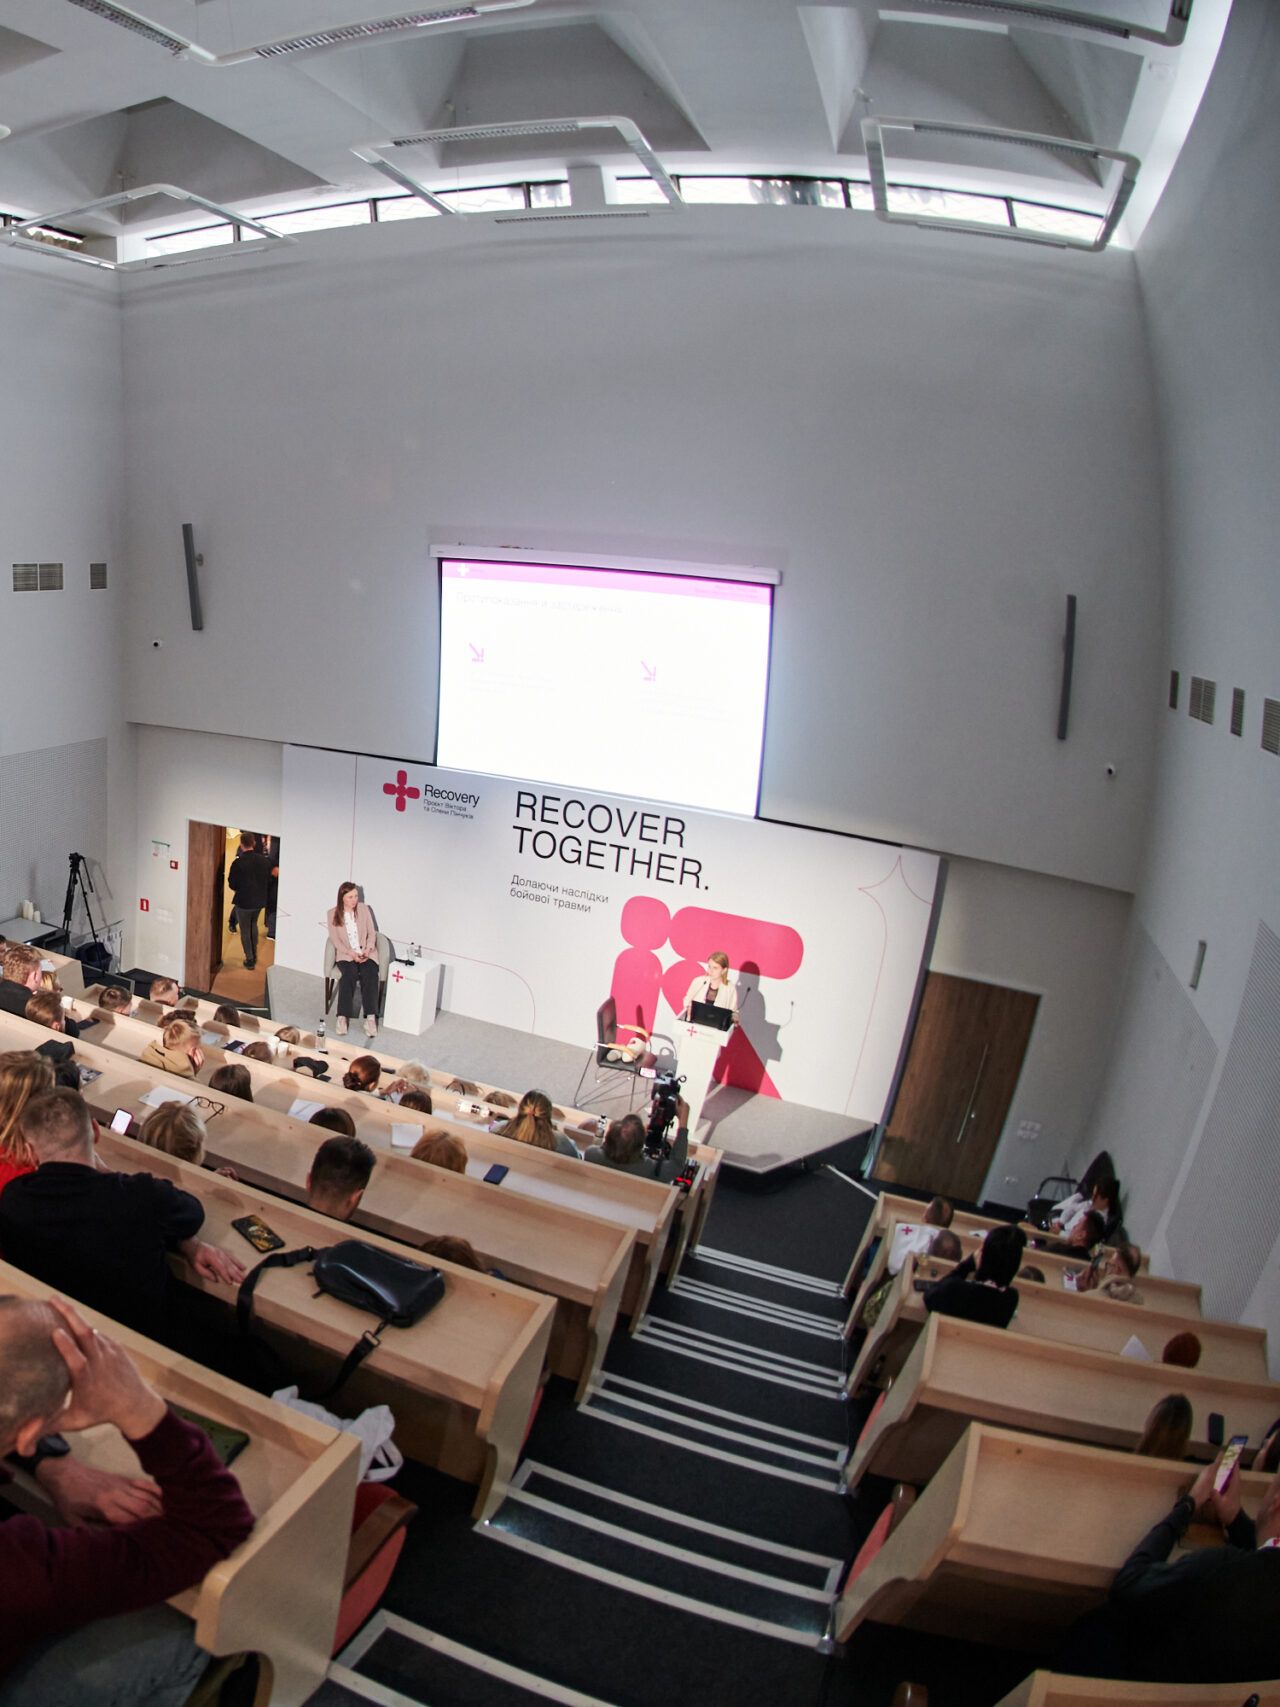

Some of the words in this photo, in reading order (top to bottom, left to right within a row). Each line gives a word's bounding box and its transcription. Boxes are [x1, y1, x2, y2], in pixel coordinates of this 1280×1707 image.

[424, 784, 480, 808] Recovery
[515, 790, 687, 848] RECOVER
[512, 825, 709, 890] TOGETHER.
[509, 888, 551, 906] бойової
[554, 898, 592, 913] травми
[511, 874, 559, 894] Долаючи
[561, 886, 609, 904] наслідки
